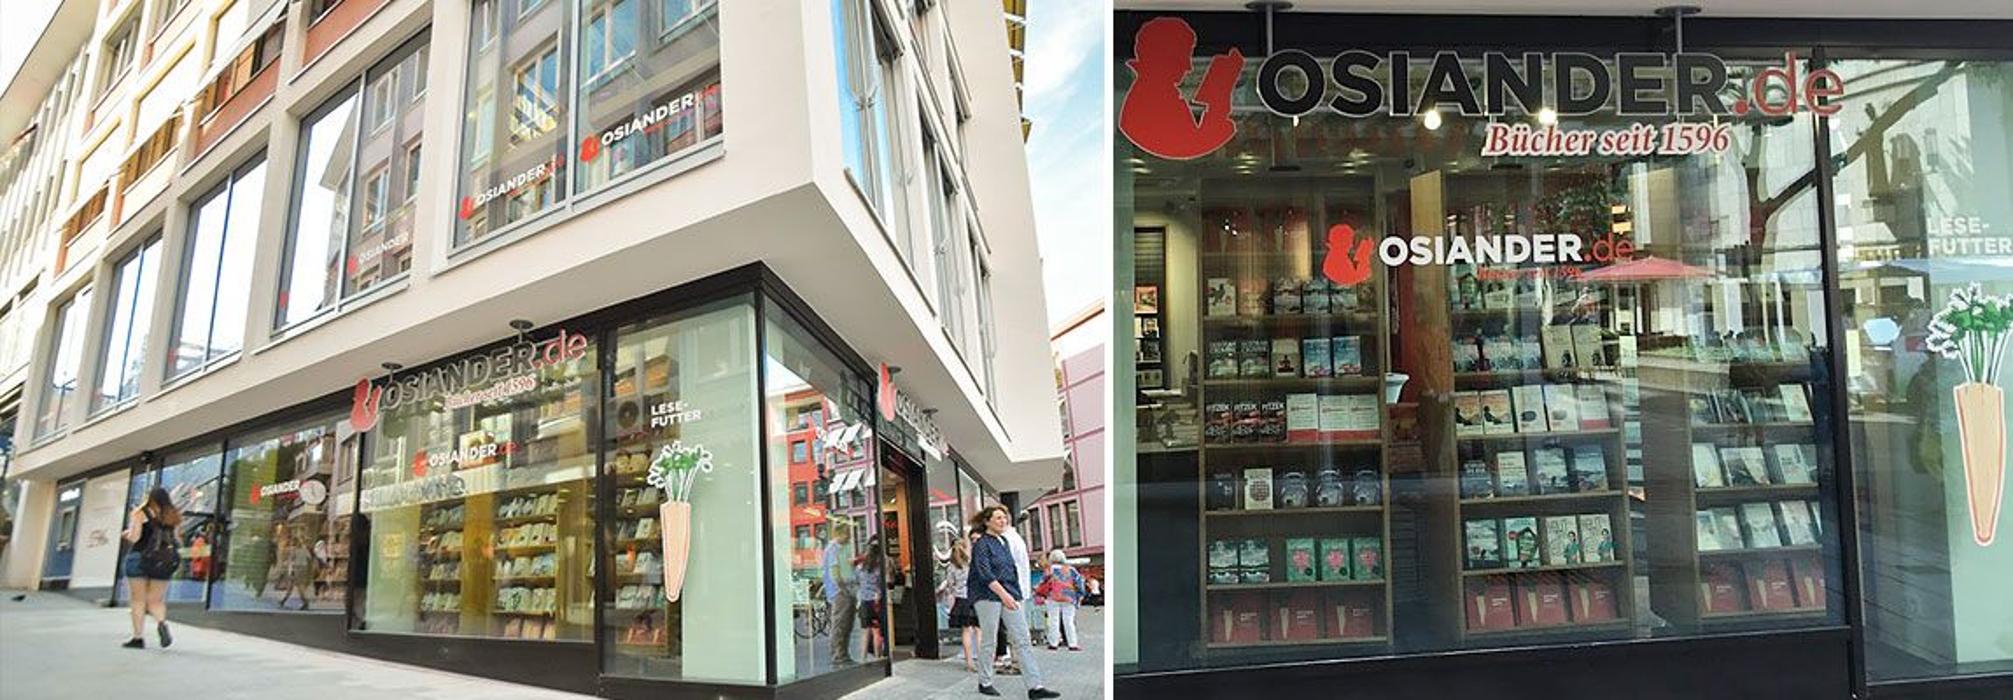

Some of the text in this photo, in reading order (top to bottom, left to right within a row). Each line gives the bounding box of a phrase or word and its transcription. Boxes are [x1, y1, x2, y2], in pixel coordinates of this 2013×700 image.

[1257, 49, 1845, 118] OSIANDER.de
[1481, 123, 1732, 156] Bücher seit 1596
[1927, 217, 1990, 234] LESE-
[1379, 232, 1634, 266] OSIANDER.de
[1928, 237, 2012, 255] FUTTER
[381, 329, 588, 410] OSIANDER.de
[651, 400, 688, 415] LESE-
[651, 409, 702, 428] FUTTER
